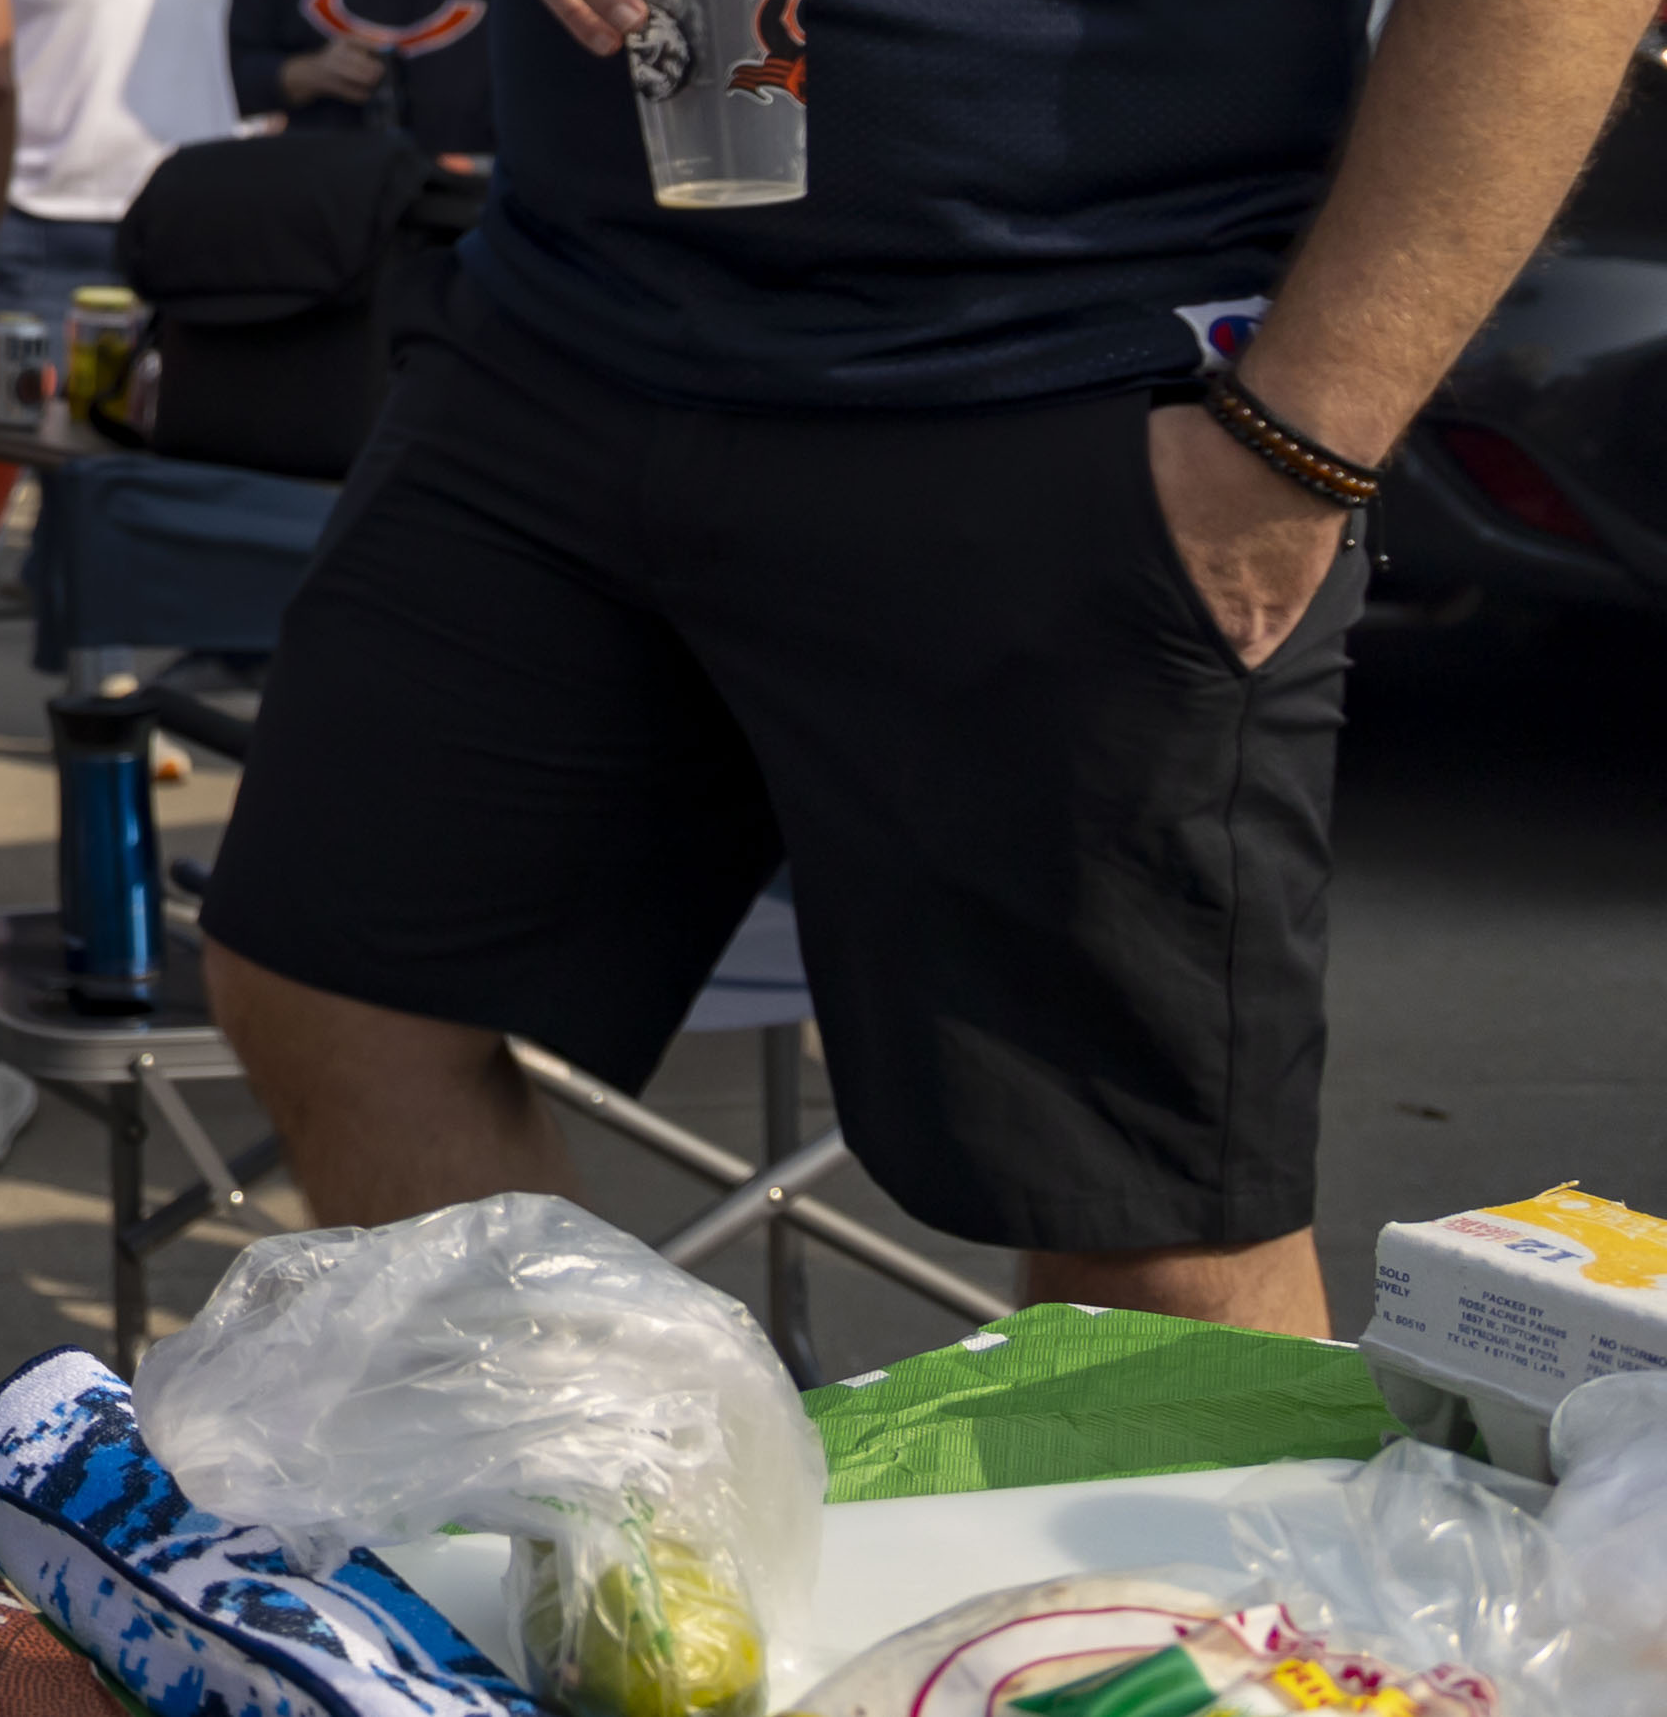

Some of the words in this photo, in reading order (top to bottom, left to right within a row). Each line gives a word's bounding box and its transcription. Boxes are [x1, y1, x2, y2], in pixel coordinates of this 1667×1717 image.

[1378, 1265, 1411, 1284] SOLD
[1458, 1296, 1487, 1314] ROSE
[1482, 1290, 1527, 1313] PACKED
[1529, 1306, 1545, 1318] BY
[1598, 1336, 1618, 1351] NO
